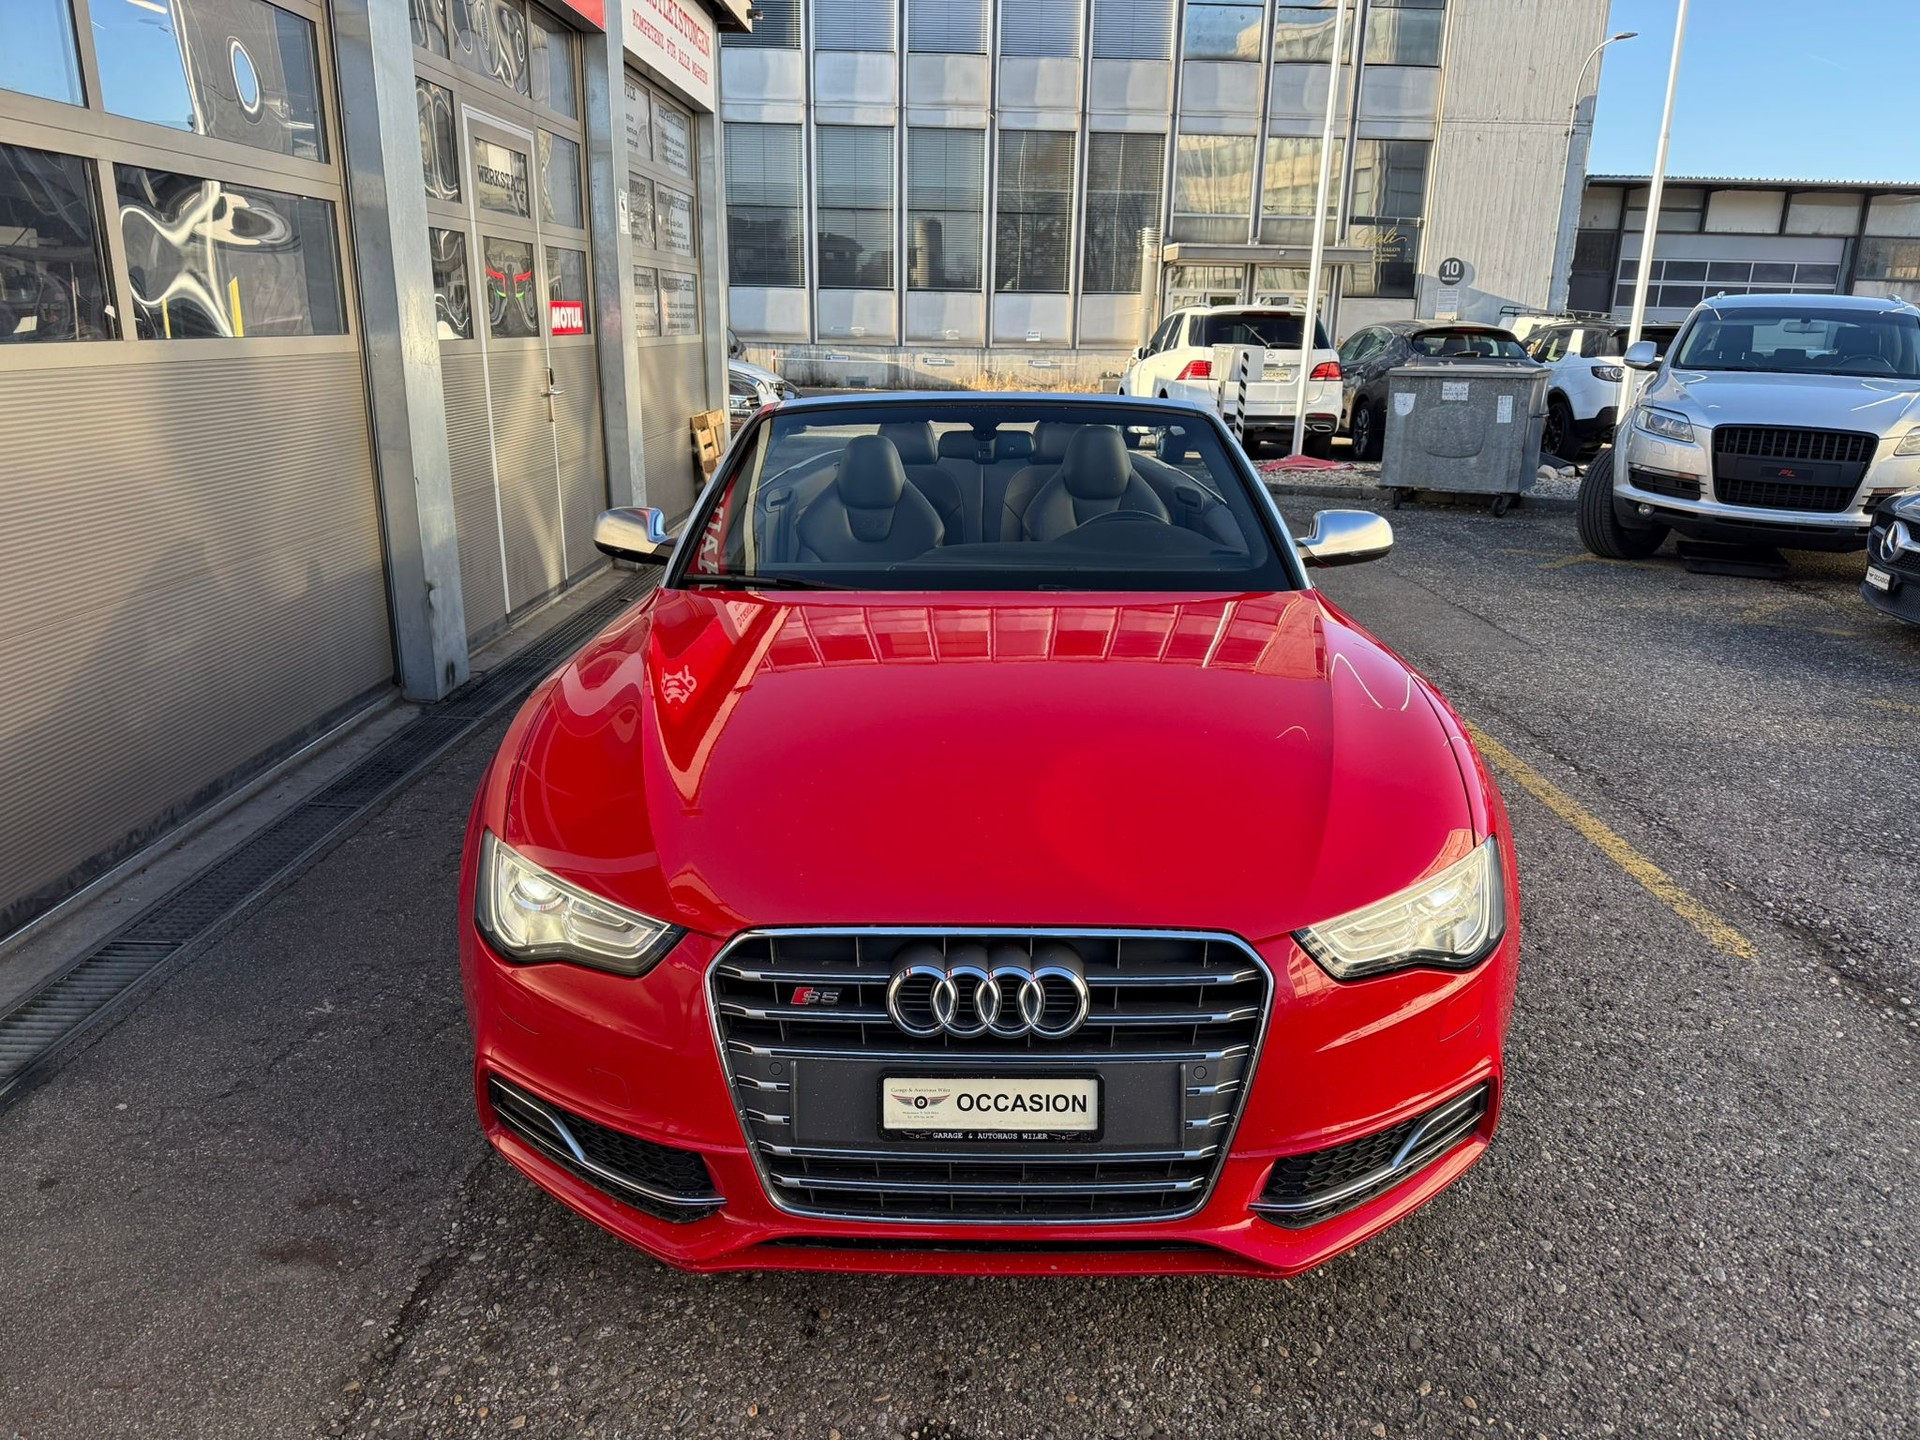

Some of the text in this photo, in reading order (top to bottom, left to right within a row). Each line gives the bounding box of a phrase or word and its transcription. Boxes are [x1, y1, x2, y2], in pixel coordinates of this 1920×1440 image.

[477, 165, 526, 195] WERKSTATT
[1444, 261, 1460, 276] 10
[551, 306, 583, 329] MOTUL
[802, 990, 839, 1005] S5
[956, 1093, 1088, 1112] OCCASION
[978, 1132, 1018, 1140] AUTOHAUS
